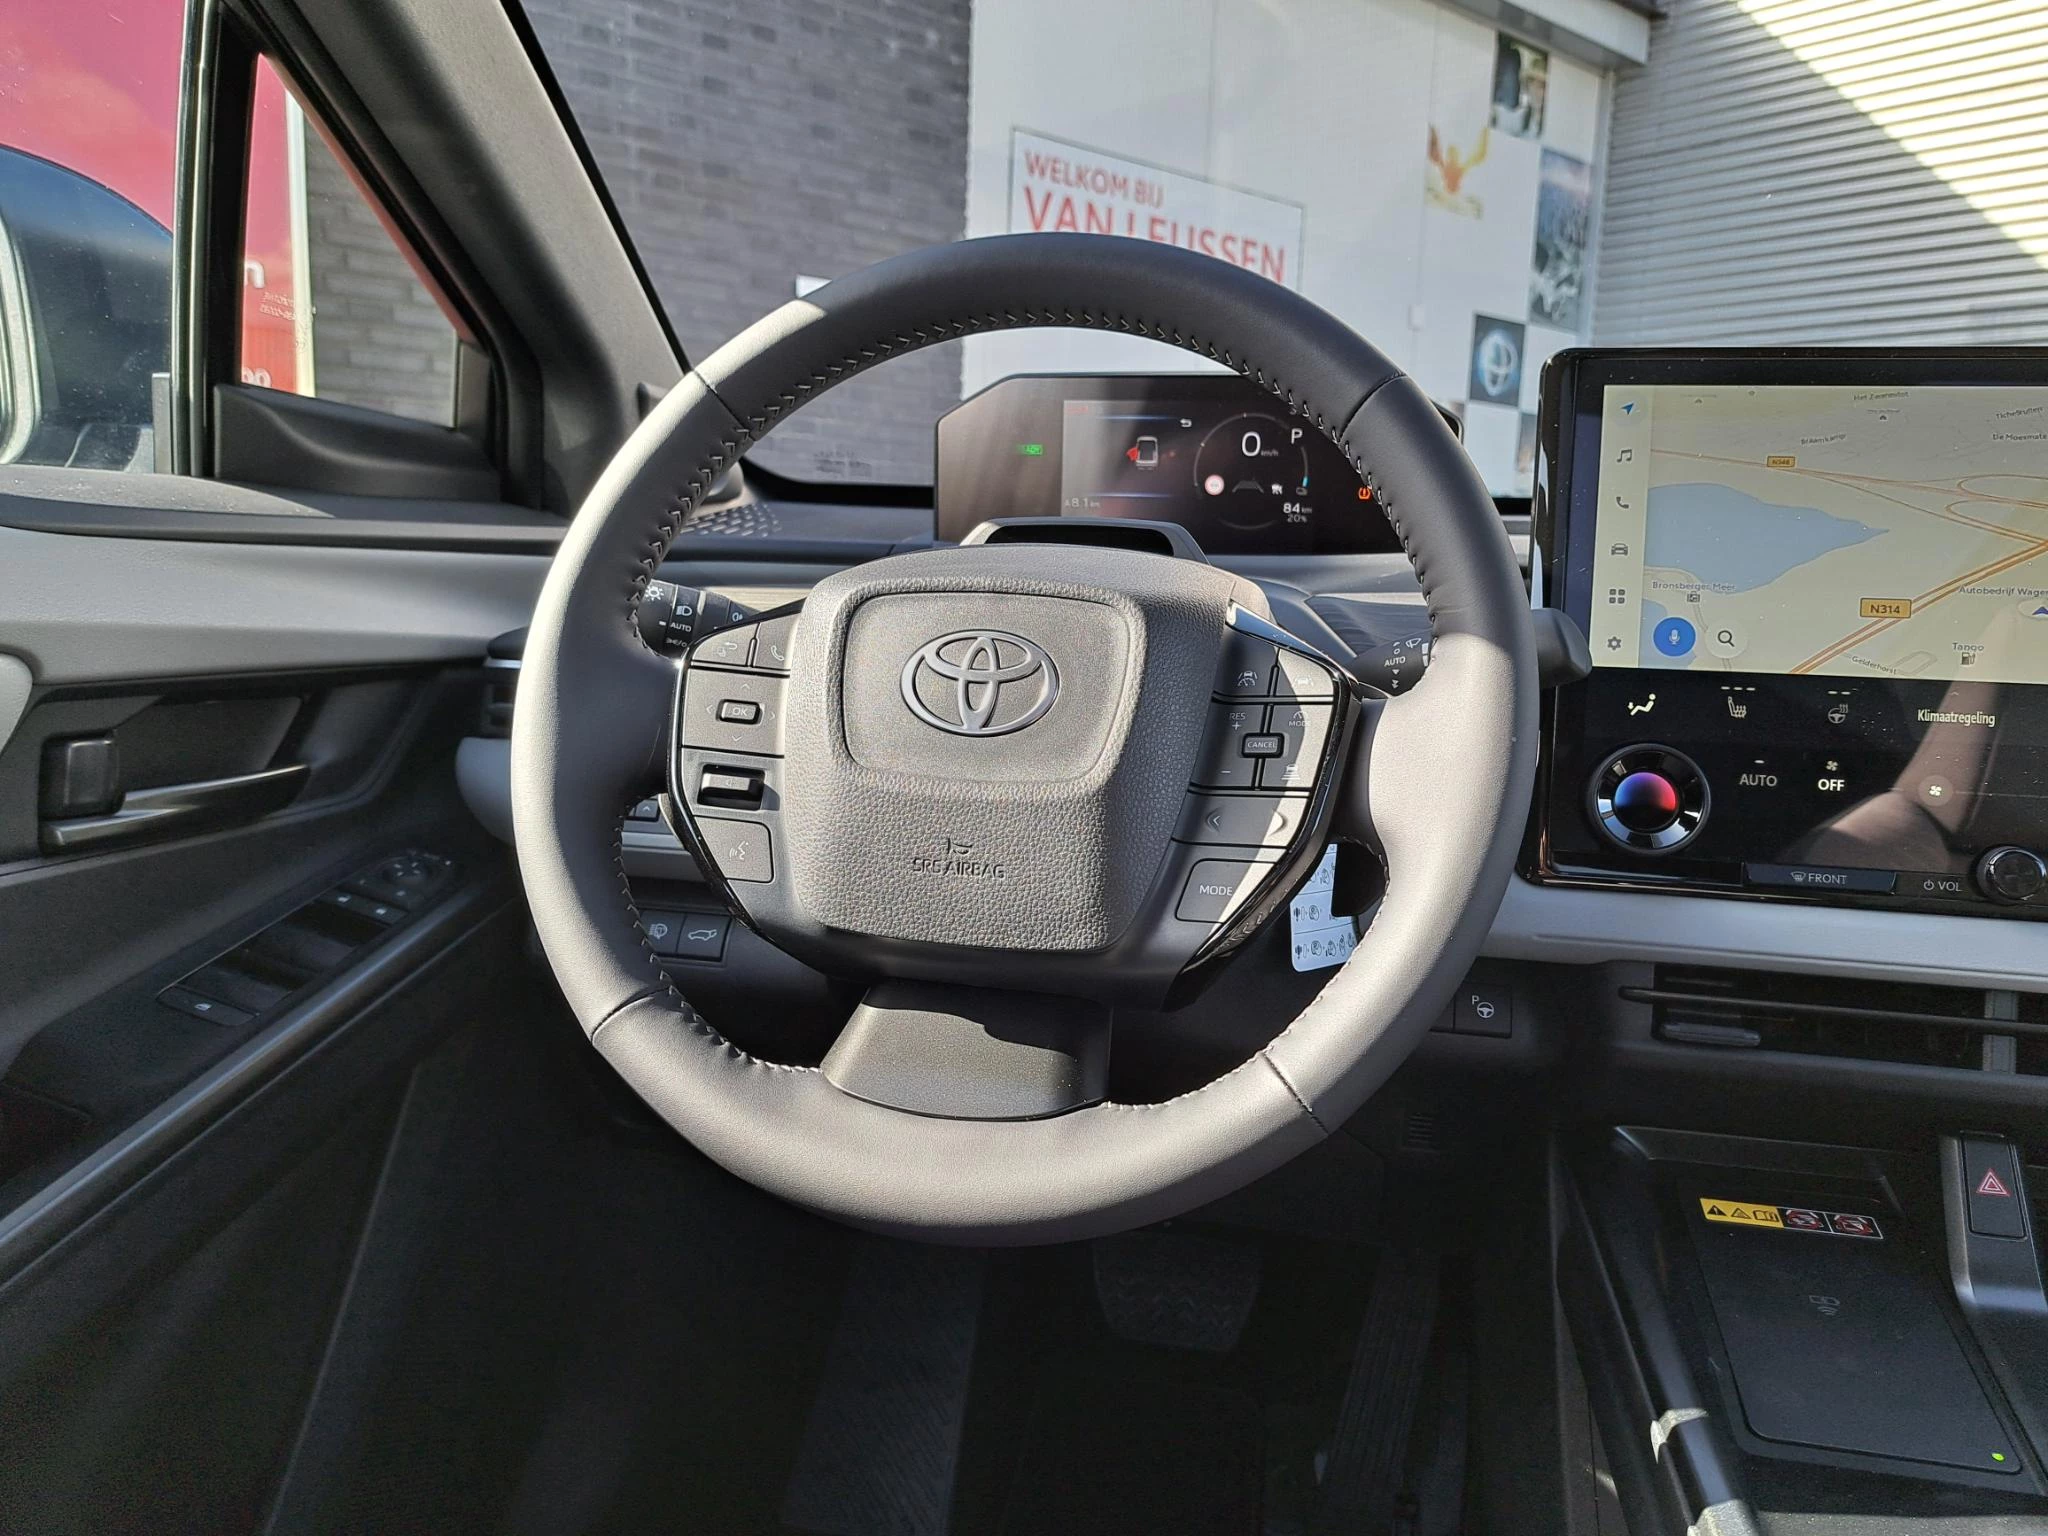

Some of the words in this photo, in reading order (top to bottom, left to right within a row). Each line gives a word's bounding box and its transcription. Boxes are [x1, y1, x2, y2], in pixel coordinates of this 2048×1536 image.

[1024, 151, 1128, 199] WELKOM
[1133, 180, 1164, 209] BIJ
[1024, 185, 1112, 234] VAN
[1291, 428, 1303, 445] P
[1241, 431, 1261, 457] 0
[1261, 449, 1279, 457] km/h
[1283, 502, 1300, 514] 84
[1301, 506, 1312, 514] km
[1287, 514, 1307, 523] 20%
[1959, 586, 2015, 597] Autobedrijf
[1870, 603, 1901, 614] N314
[670, 621, 692, 633] AUTO
[1952, 642, 1985, 652] Tango
[1384, 655, 1406, 667] AUTO
[732, 706, 748, 717] OK
[1229, 712, 1246, 721] RES
[1916, 708, 1996, 728] Klimaatregeling
[1247, 741, 1278, 749] CANCEL
[1739, 773, 1778, 788] AUTO
[1817, 778, 1845, 792] OFF
[943, 860, 1005, 879] AIRBAG
[1807, 872, 1848, 886] FRONT
[1199, 884, 1233, 897] MODE
[1938, 880, 1963, 893] VOL
[1471, 994, 1480, 1005] P
